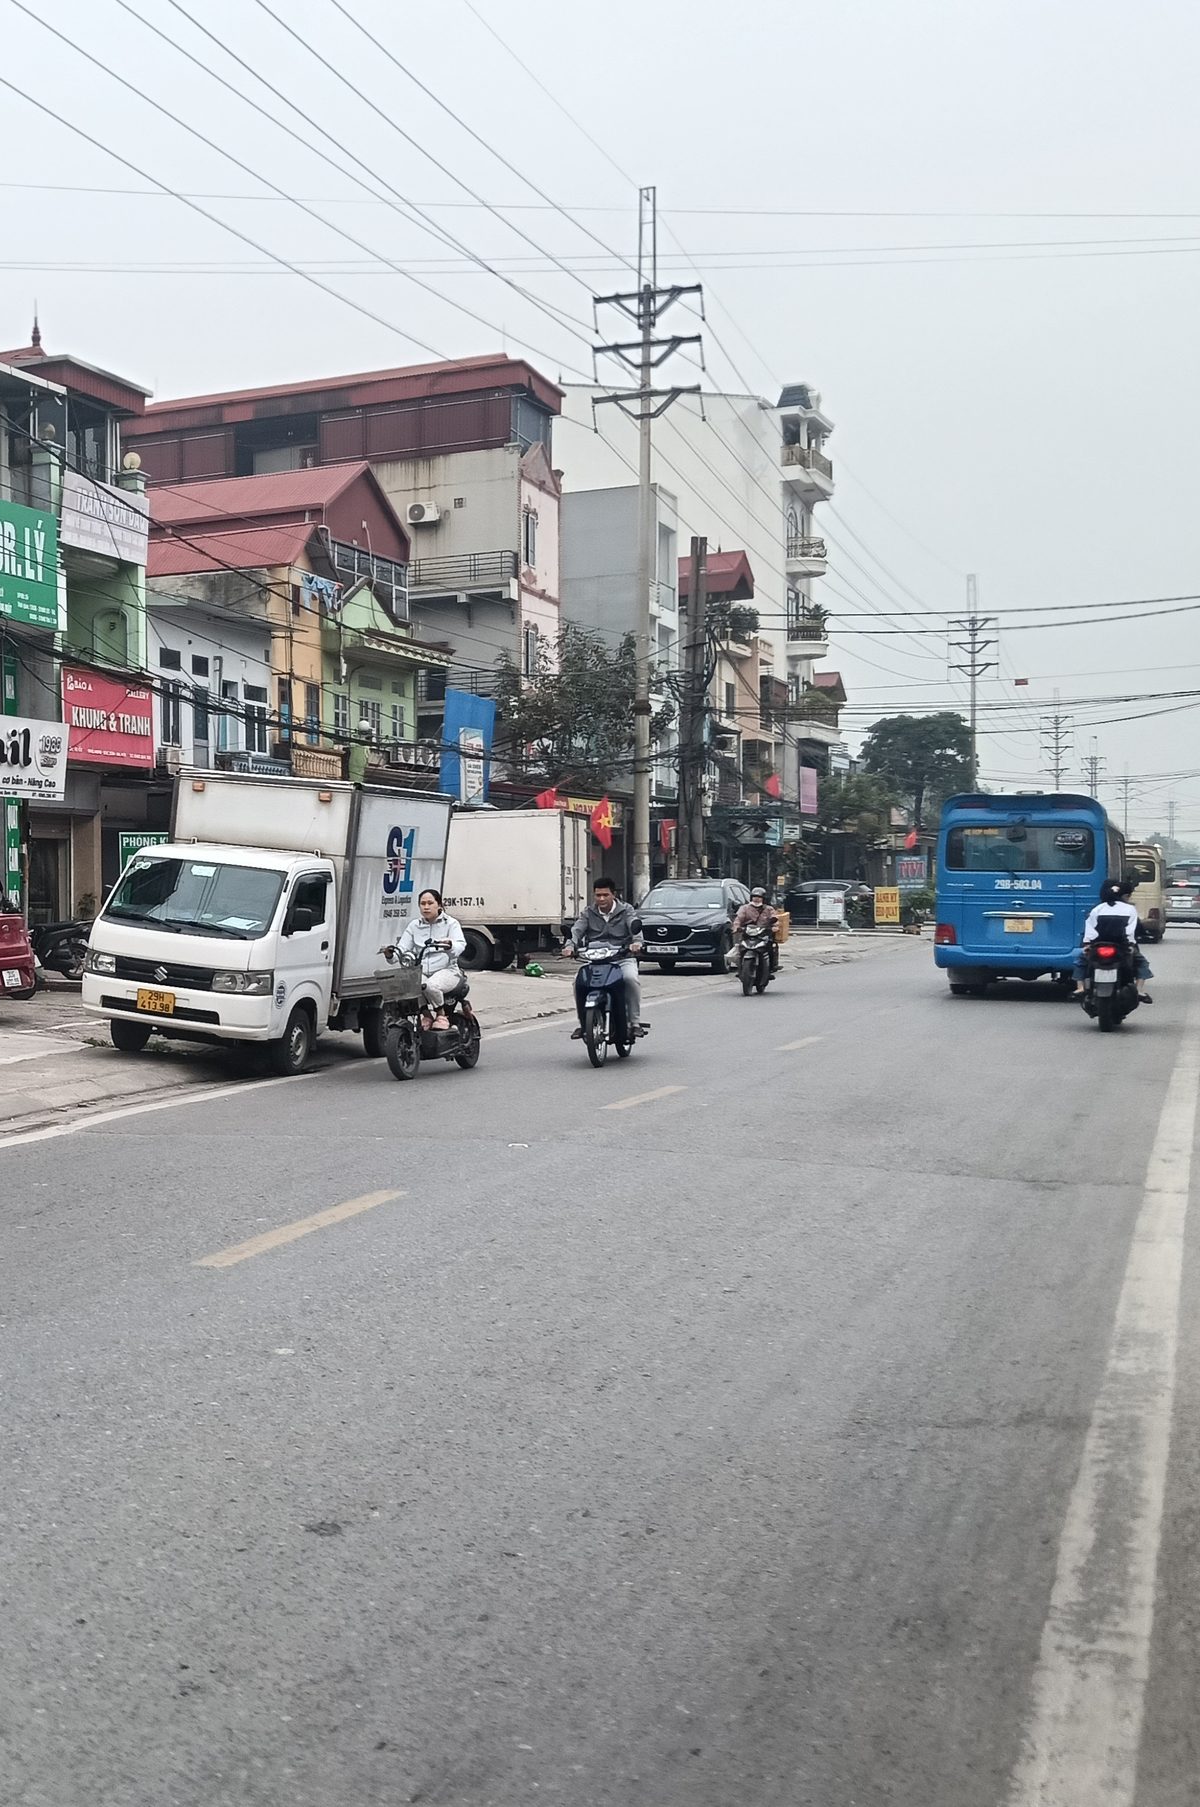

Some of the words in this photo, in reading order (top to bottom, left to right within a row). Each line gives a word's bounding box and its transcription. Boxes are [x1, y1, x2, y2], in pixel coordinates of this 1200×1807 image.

[72, 706, 107, 731] KHUNG
[108, 712, 117, 732] &
[118, 713, 152, 737] TRANH
[122, 834, 157, 847] PHÒNG
[383, 825, 415, 895] S1
[148, 991, 165, 1002] 29H
